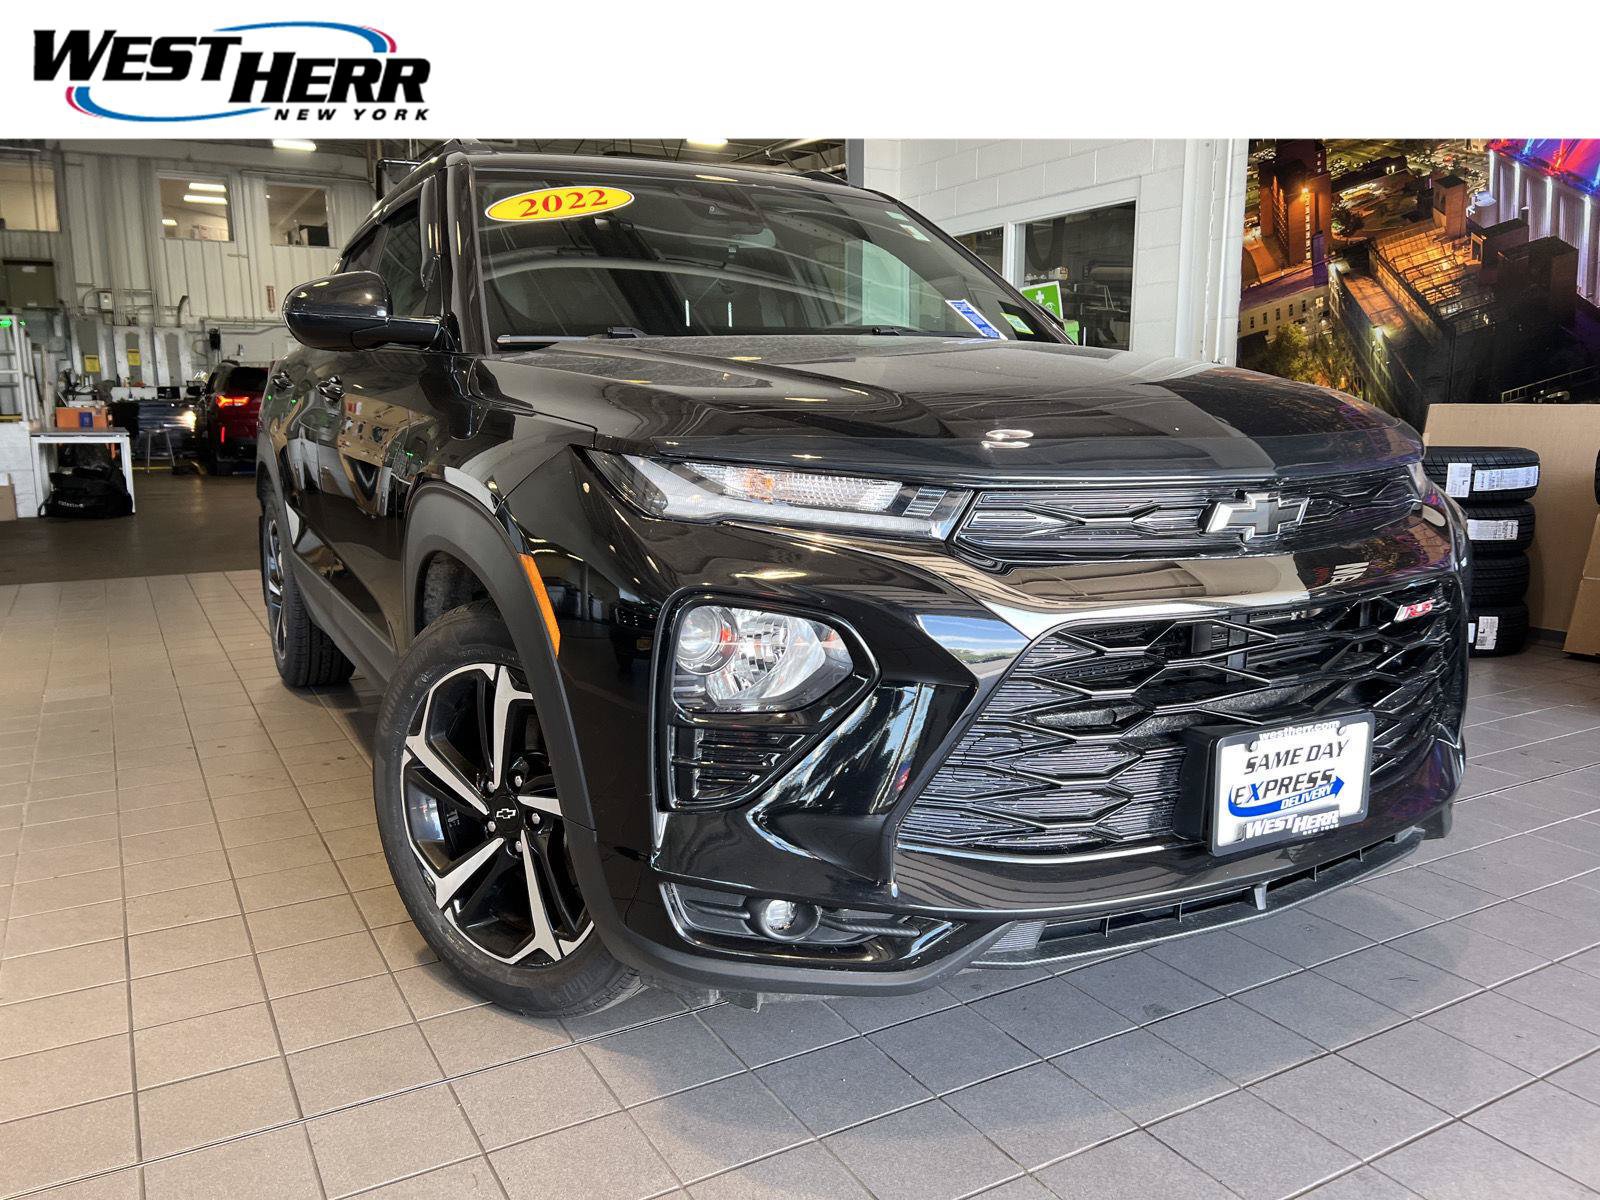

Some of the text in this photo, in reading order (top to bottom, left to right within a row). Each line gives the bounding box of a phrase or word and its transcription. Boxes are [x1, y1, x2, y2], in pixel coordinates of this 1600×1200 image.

[519, 189, 608, 217] 2022
[1244, 739, 1350, 775] SAME DAY
[1234, 768, 1335, 805] EXPRESS
[1281, 783, 1333, 809] DELIVERY
